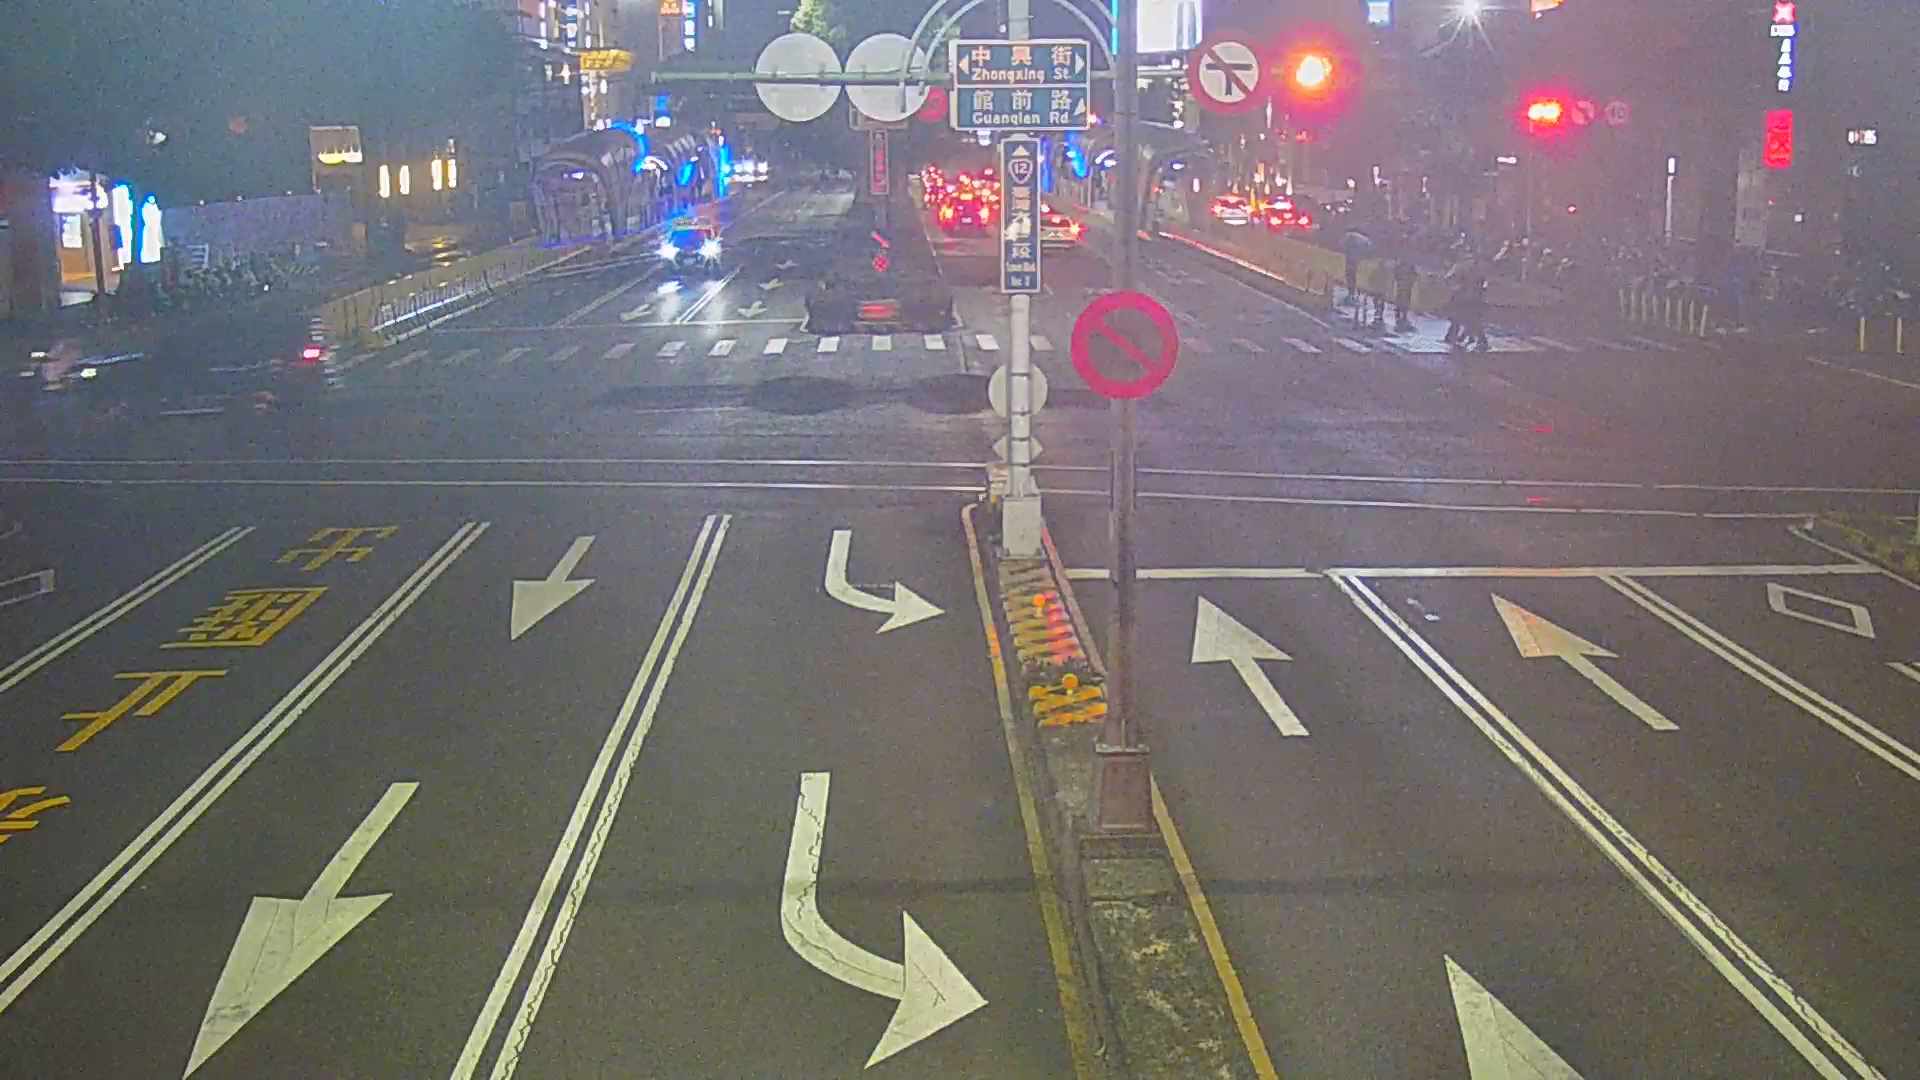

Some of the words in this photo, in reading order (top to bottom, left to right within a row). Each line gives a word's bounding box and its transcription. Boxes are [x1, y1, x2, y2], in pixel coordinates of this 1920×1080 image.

[971, 46, 1072, 66] 中興街
[972, 67, 1045, 83] Zhongxing
[973, 90, 1072, 111] 館前路
[972, 112, 1040, 126] Guanqian
[1014, 165, 1029, 175] 12
